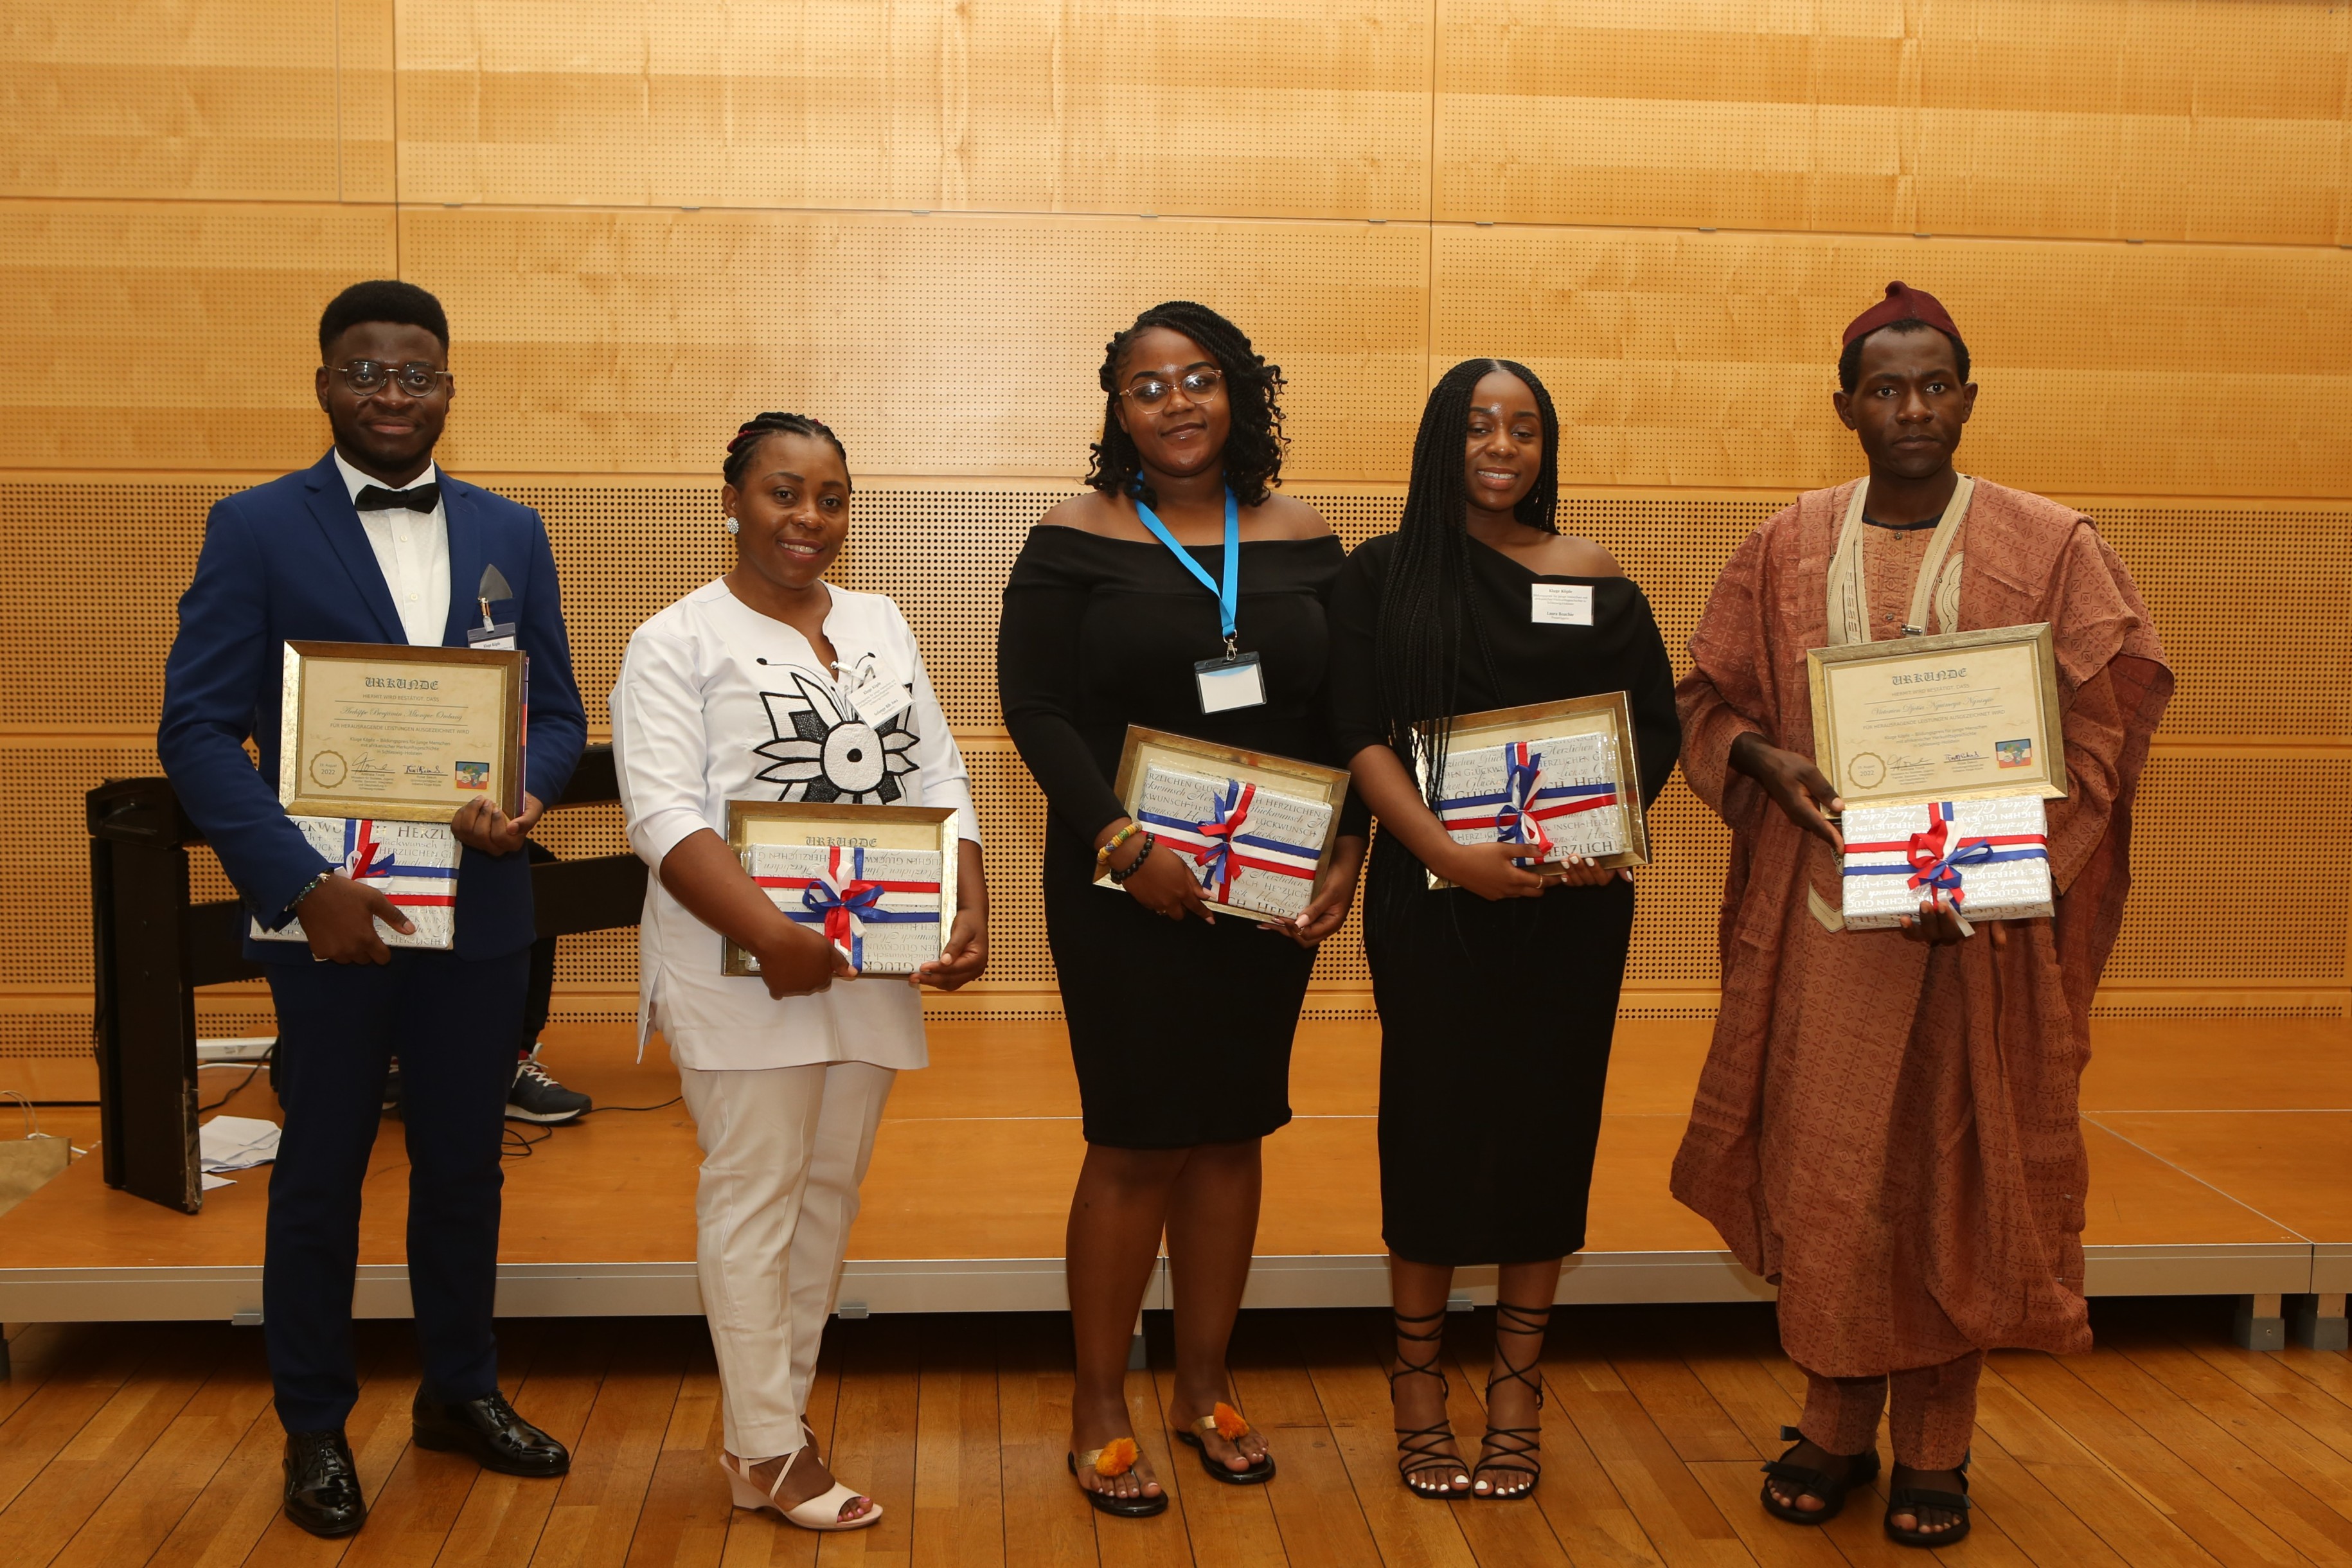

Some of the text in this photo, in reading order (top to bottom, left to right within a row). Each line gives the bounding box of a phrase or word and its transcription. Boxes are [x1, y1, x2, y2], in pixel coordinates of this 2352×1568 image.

[365, 677, 439, 690] URKUNDE
[1892, 668, 1968, 686] URKUNDE
[340, 706, 368, 717] Archippe
[370, 707, 402, 719] Benjamin
[1874, 720, 1916, 729] HERAUSRAGENDE
[1949, 711, 1990, 721] AUSGEZEICHNET
[1446, 756, 1475, 768] zlichen
[1540, 742, 1594, 758] Herzlichen
[1464, 764, 1506, 777] GLÜCKWU
[1145, 781, 1186, 797] ckwunsch
[1148, 772, 1191, 788] RZLICHEN
[1267, 798, 1321, 817] HERZLICHEN
[1140, 803, 1180, 819] kwunsch
[1141, 793, 1186, 807] KWUNSCH
[1256, 816, 1317, 839] LÜCKWUNSCH
[1960, 814, 1997, 824] GLÜCK
[1855, 819, 2042, 833] Herzlichen HERZLICHEN
[398, 825, 448, 841] HERZL
[1457, 831, 1499, 841] HERZLICH
[806, 836, 877, 848] URKUNDE
[379, 846, 440, 858] HERZLICHEN
[769, 853, 826, 862] HERZLICHEN
[889, 867, 941, 880] Herzlichen
[1962, 869, 2017, 881] HERZLICHE
[2000, 877, 2047, 889] ckwunsch
[1264, 882, 1311, 899] HERZLICH
[1964, 888, 2020, 900] GLÜCKWUN
[1256, 891, 1305, 910] Herzliche
[390, 934, 443, 947] HERZLICHE
[901, 933, 940, 944] kwunsch
[873, 952, 935, 962] Glückwunsch
